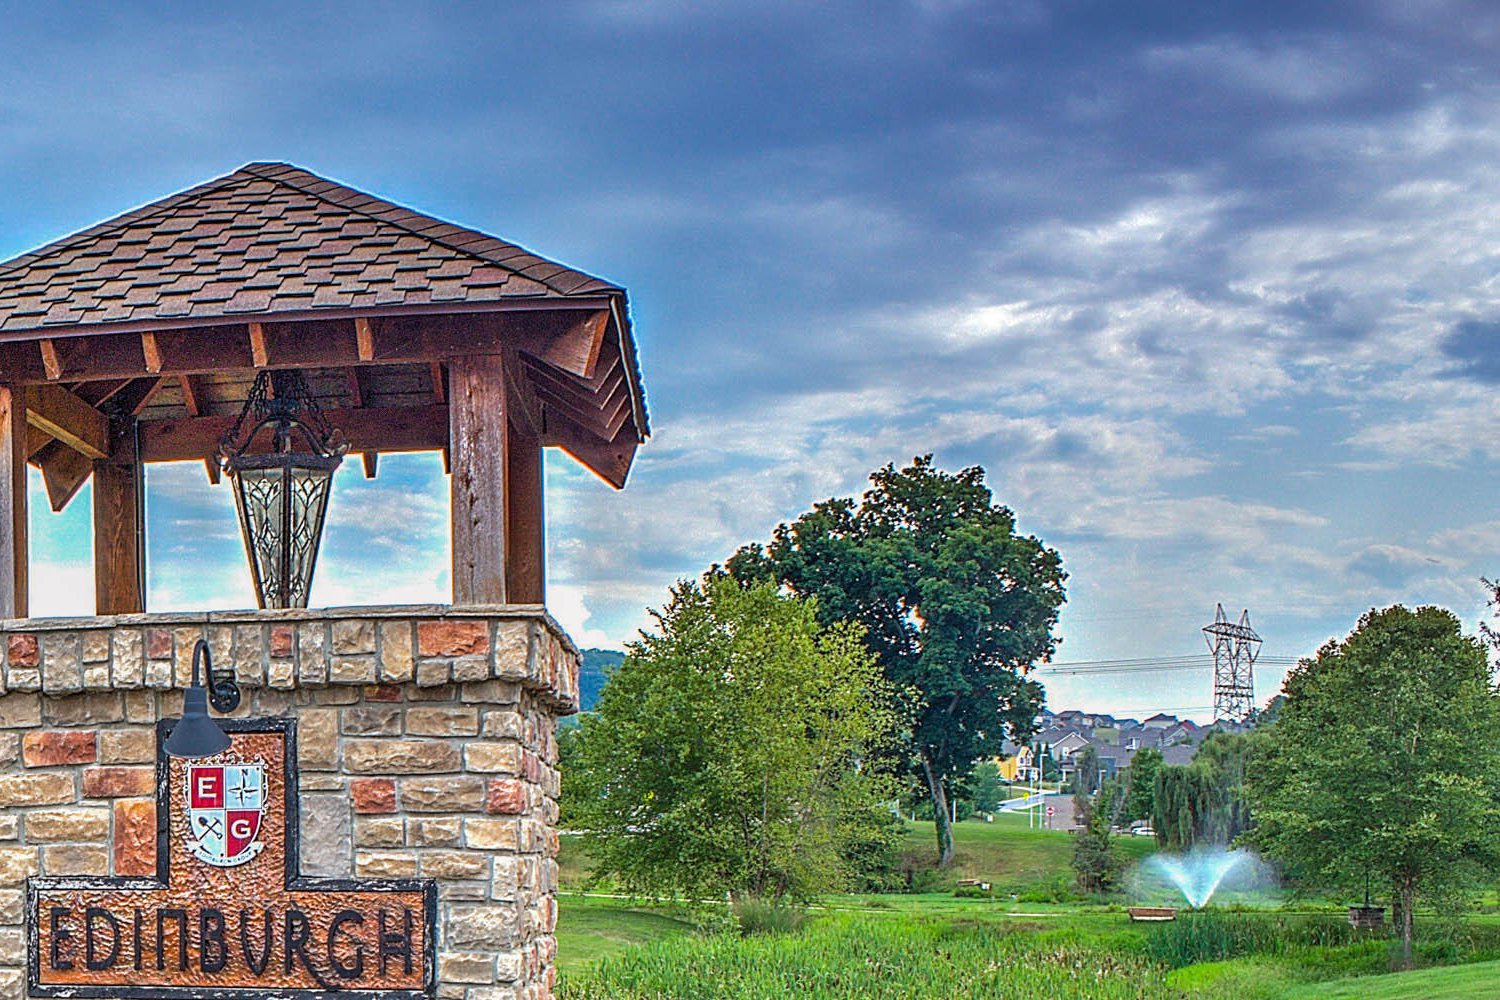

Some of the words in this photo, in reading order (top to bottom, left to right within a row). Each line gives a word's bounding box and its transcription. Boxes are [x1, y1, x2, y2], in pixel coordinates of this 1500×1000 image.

[198, 776, 217, 798] E
[230, 819, 251, 839] G
[50, 902, 412, 991] EDINBURGH
